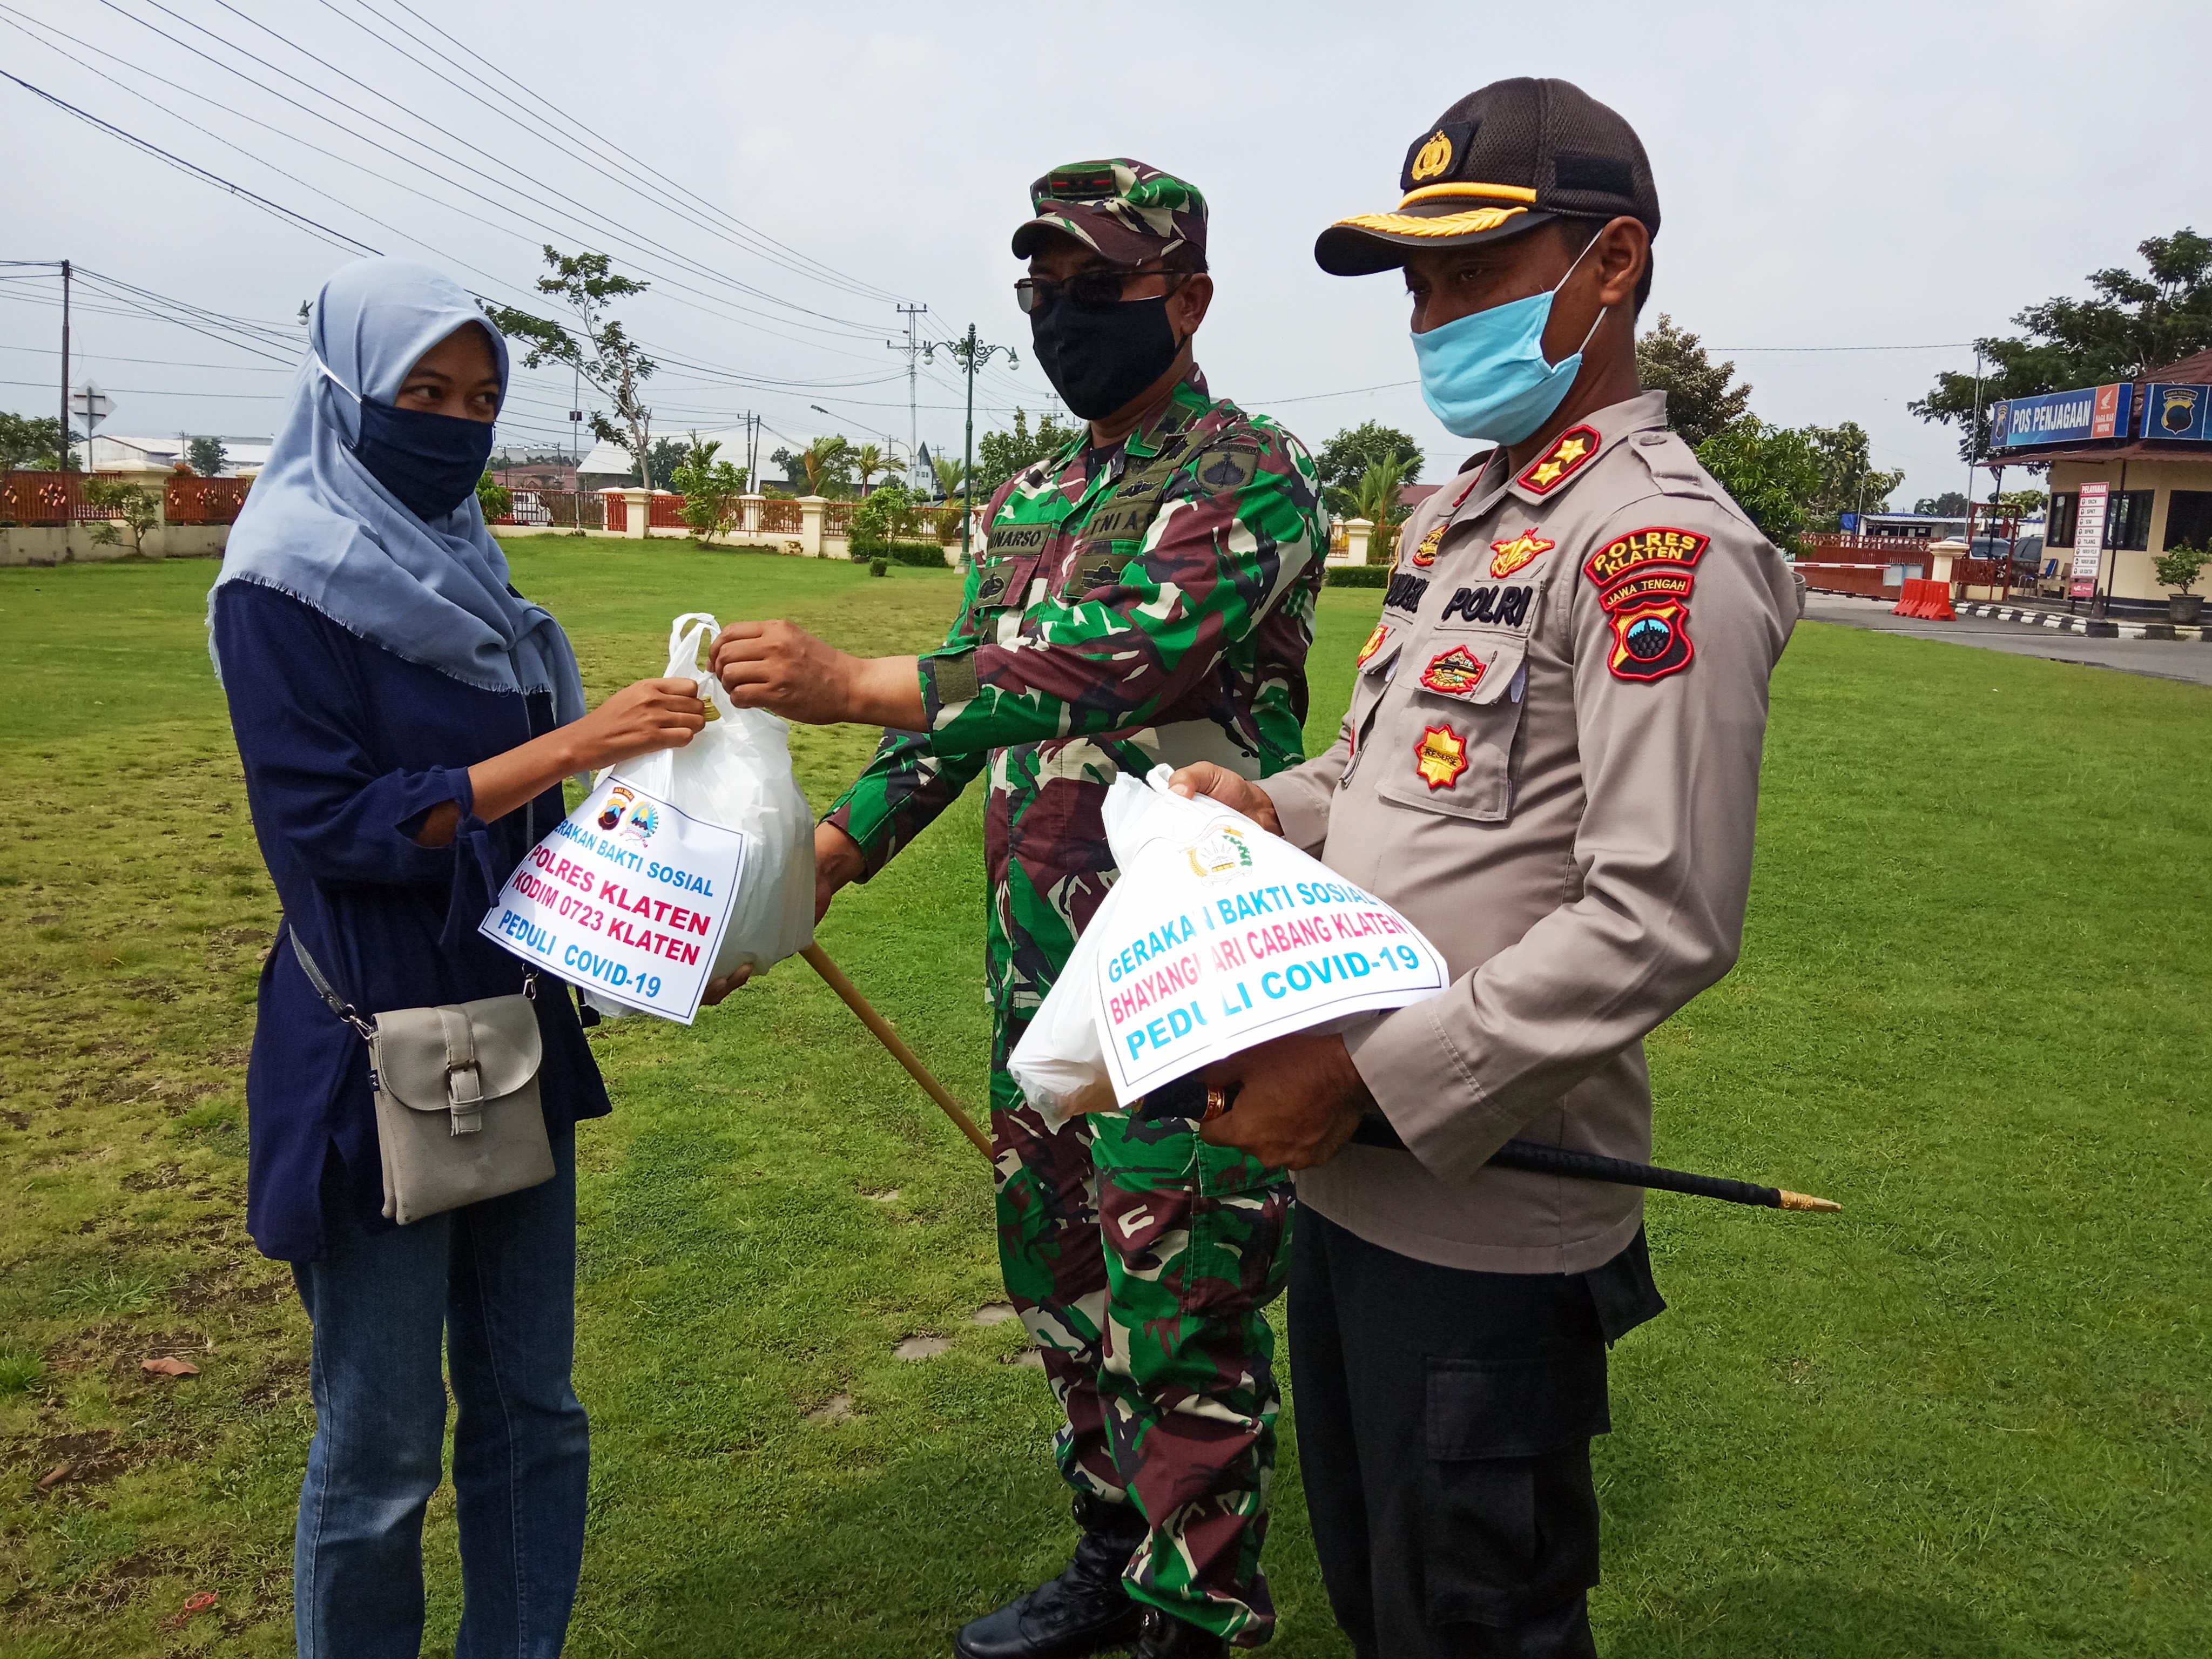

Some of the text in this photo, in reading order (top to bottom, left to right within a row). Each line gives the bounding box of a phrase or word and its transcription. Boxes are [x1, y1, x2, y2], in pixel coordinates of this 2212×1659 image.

[2012, 400, 2092, 433] POS PENJAGAAN
[1090, 512, 1121, 535] TNI
[1594, 532, 1697, 571] POLRES
[1604, 547, 1683, 576] KLATEN
[1441, 585, 1533, 627] POLRI
[1608, 579, 1686, 605] JAWA TENGAH
[1424, 748, 1459, 766] RESERSE
[597, 840, 644, 872] BAKTI
[646, 862, 713, 897] SOSIAL
[528, 845, 711, 936] POLRES KLATEN
[1216, 885, 1294, 925] BAKTI
[1297, 882, 1378, 906] SOSIAL
[512, 869, 700, 966] KODIM 0723 KLATEN
[1246, 915, 1333, 959] CABANG
[1330, 912, 1408, 940] KLATEN
[498, 909, 662, 998] PEDULI COVID-19
[1260, 945, 1419, 1000] COVID-19
